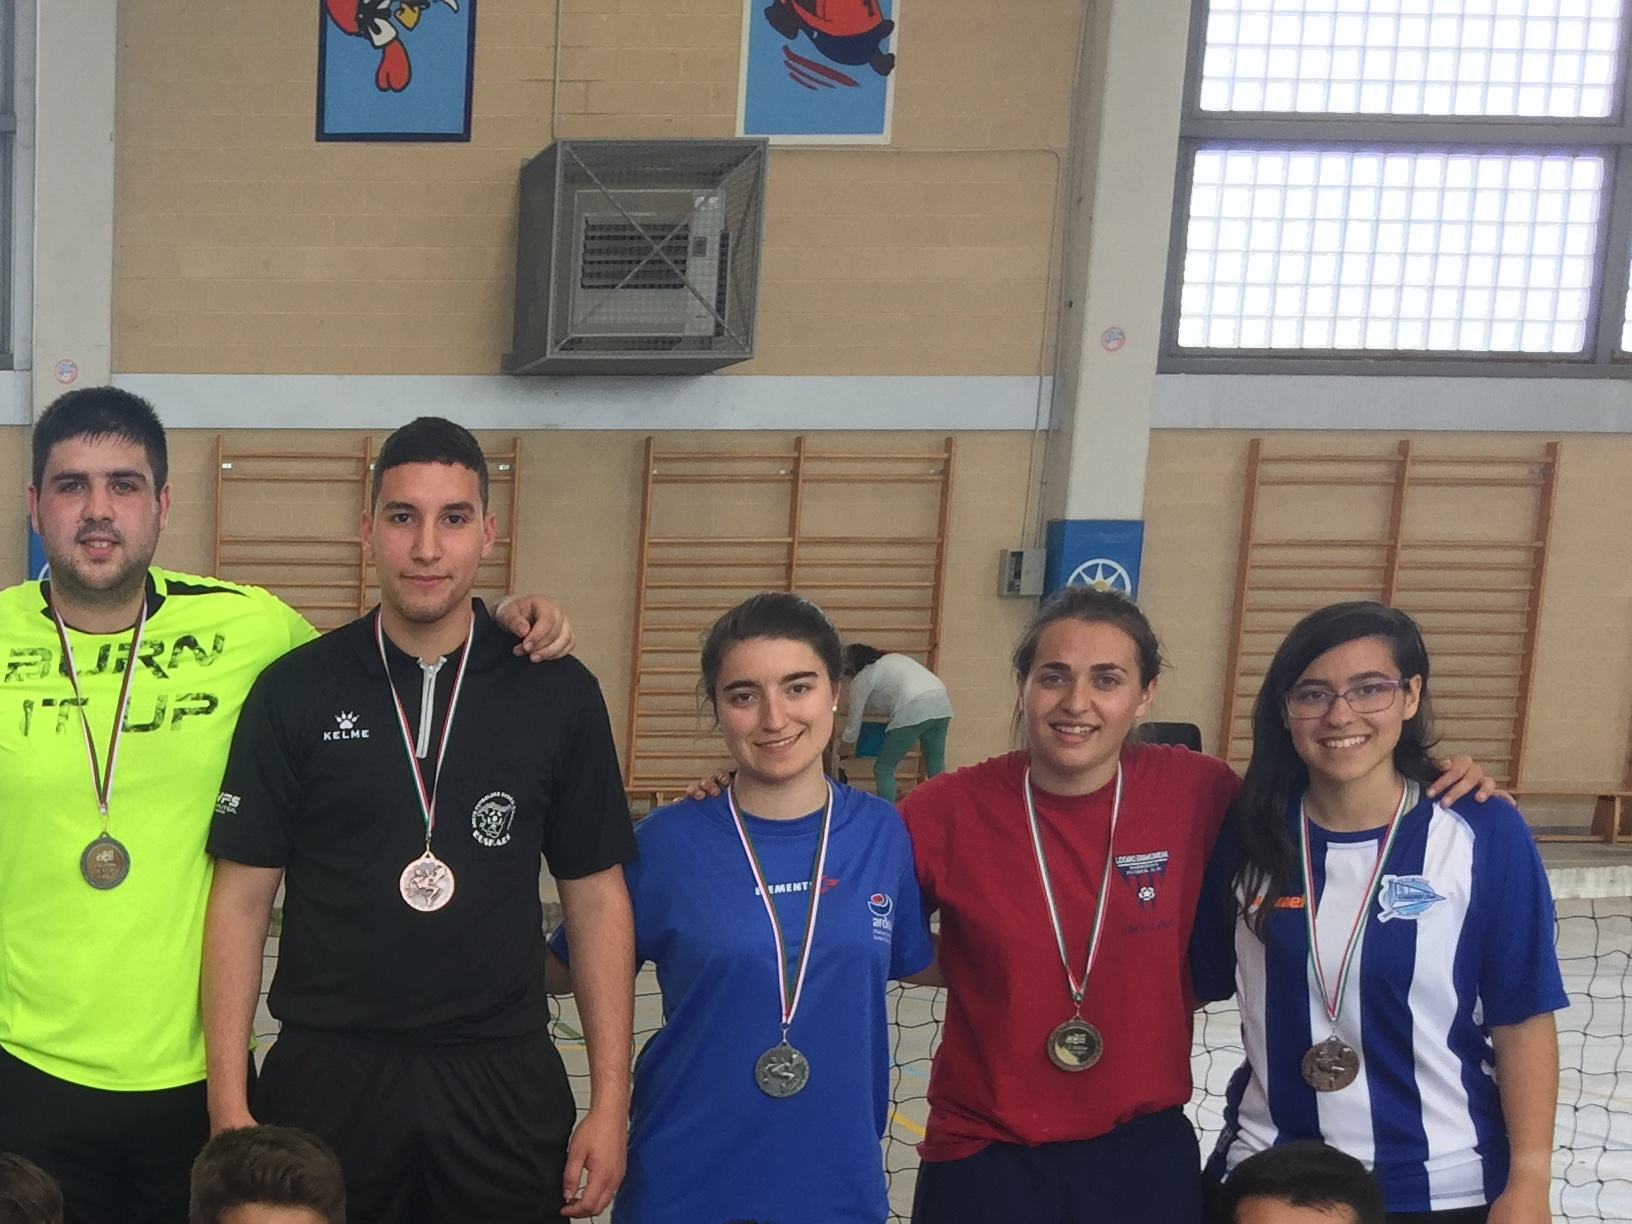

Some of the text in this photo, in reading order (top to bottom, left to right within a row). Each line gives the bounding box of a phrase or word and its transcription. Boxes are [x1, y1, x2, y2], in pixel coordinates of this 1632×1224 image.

[4, 632, 225, 683] BURN
[121, 692, 218, 733] UP
[323, 729, 370, 741] KELME
